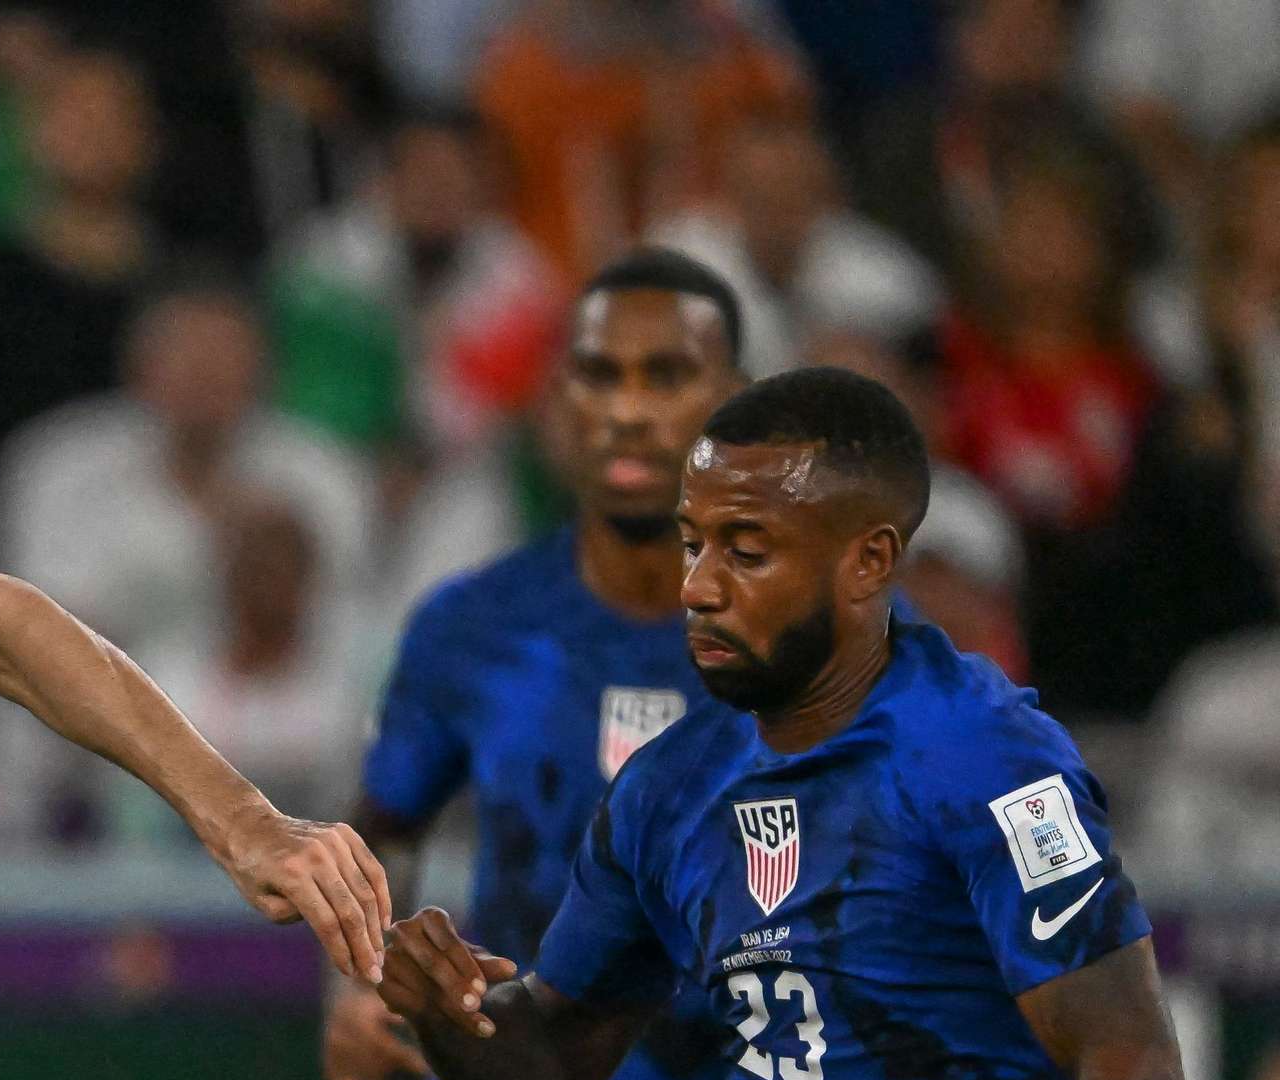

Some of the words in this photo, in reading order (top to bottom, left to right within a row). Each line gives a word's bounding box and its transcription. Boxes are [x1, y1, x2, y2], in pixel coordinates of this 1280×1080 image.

[740, 804, 796, 850] USA
[1034, 828, 1064, 848] UNITES
[740, 930, 762, 947] IRAN
[762, 928, 773, 943] VS
[774, 926, 791, 940] USA
[730, 950, 770, 969] NOVEMBER
[769, 949, 793, 963] 2022
